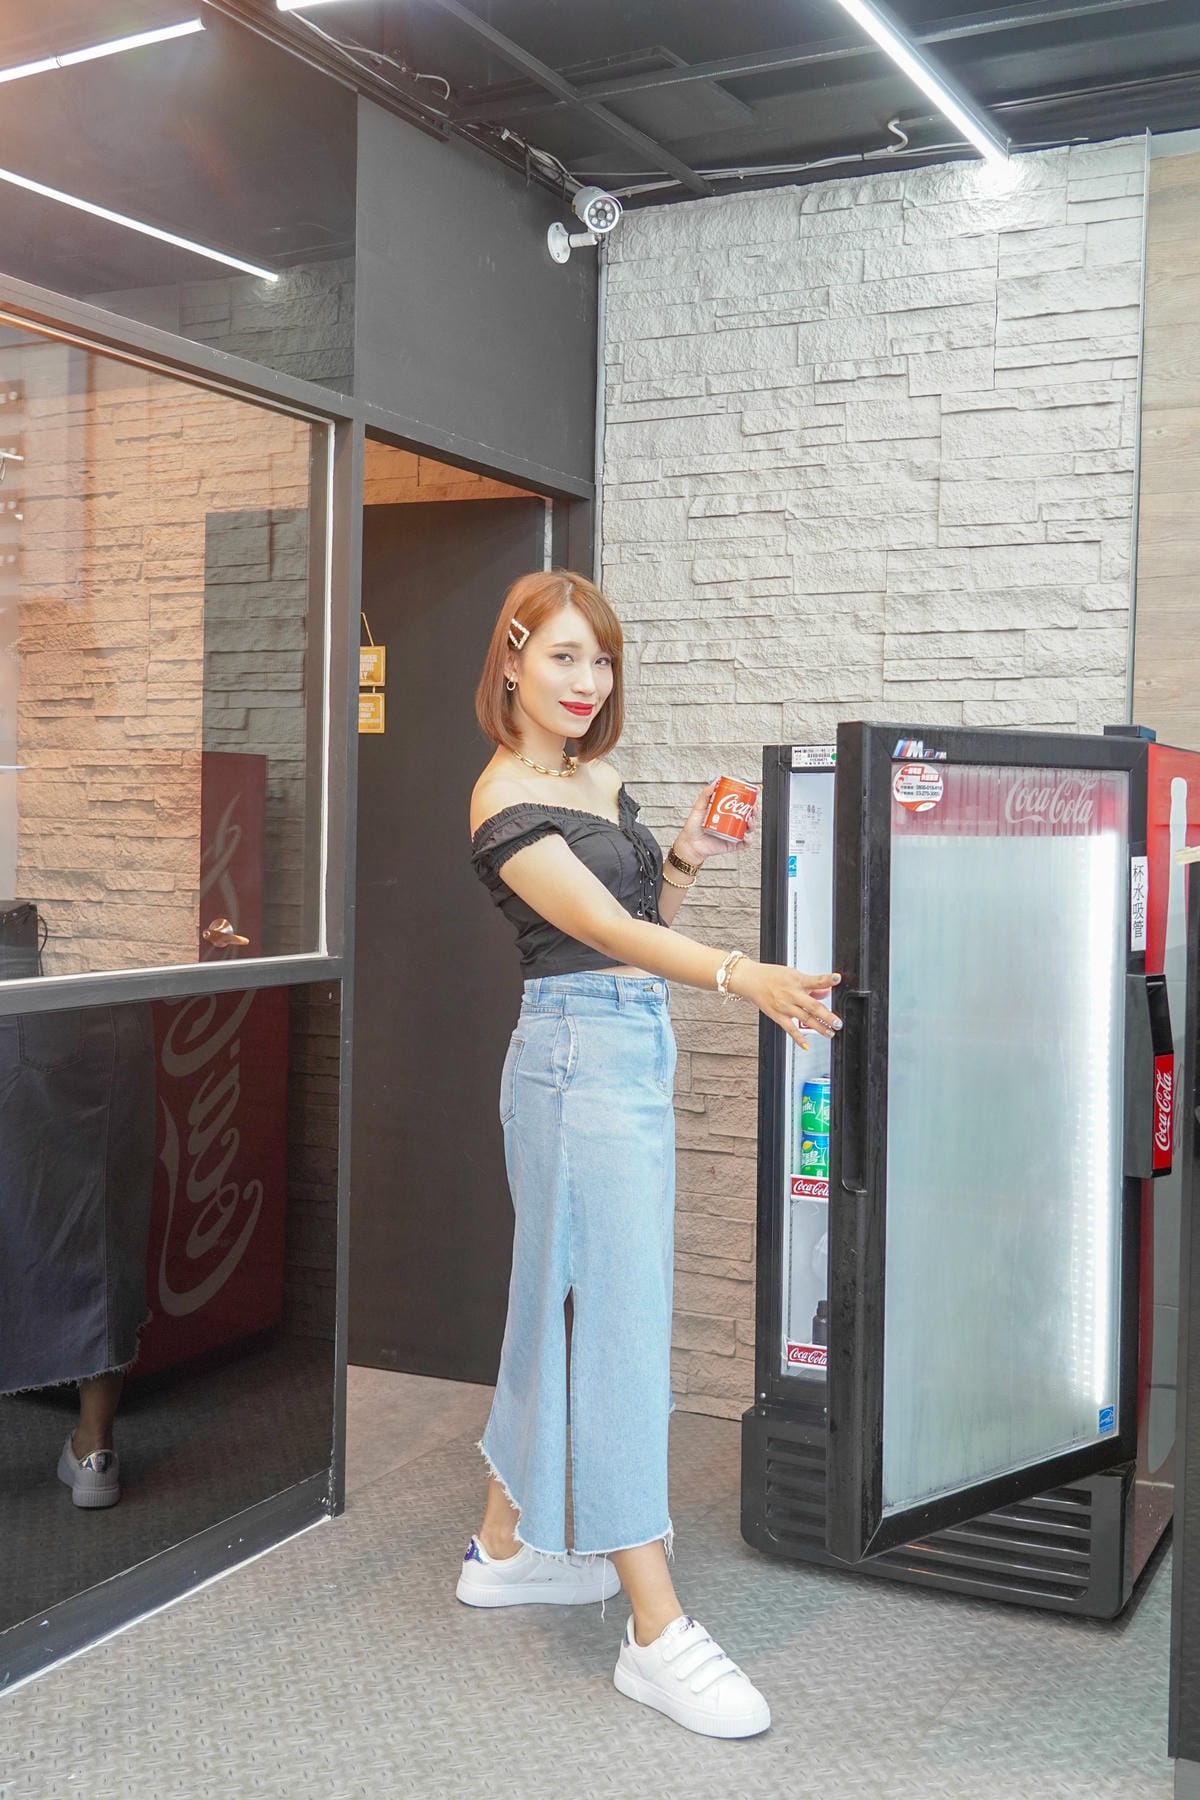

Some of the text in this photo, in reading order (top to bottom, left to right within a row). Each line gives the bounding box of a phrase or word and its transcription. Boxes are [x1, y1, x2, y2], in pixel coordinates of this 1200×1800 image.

[1005, 777, 1097, 824] Coca-Cola
[1132, 864, 1144, 939] 杯水吸管
[1154, 1069, 1172, 1152] Coca-Cola
